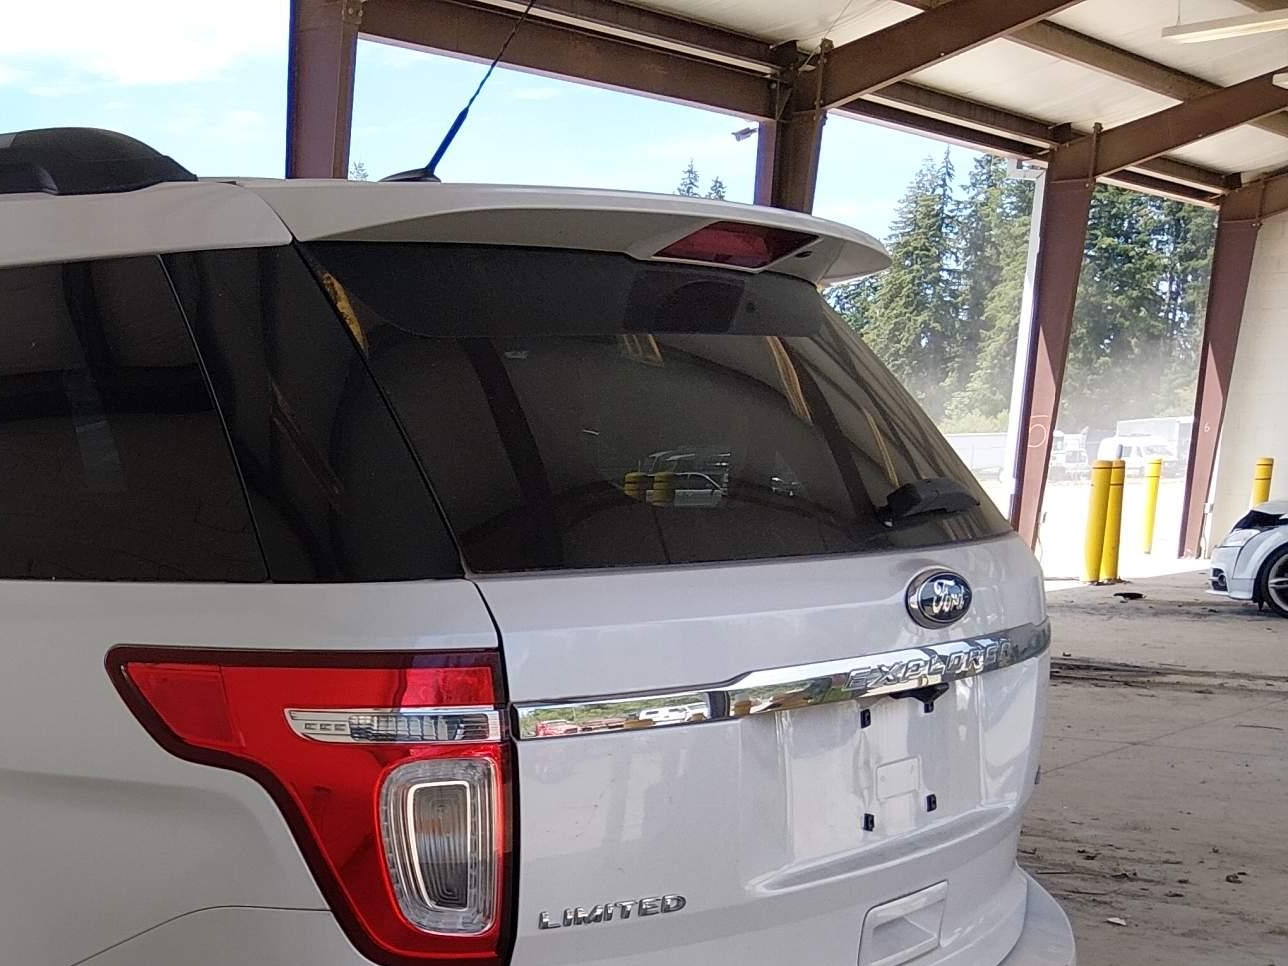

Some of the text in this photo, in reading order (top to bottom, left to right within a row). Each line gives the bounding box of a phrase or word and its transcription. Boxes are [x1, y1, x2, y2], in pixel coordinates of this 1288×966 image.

[932, 579, 965, 613] Ford
[841, 637, 1012, 691] EXPLORER
[538, 893, 687, 930] LIMITED
